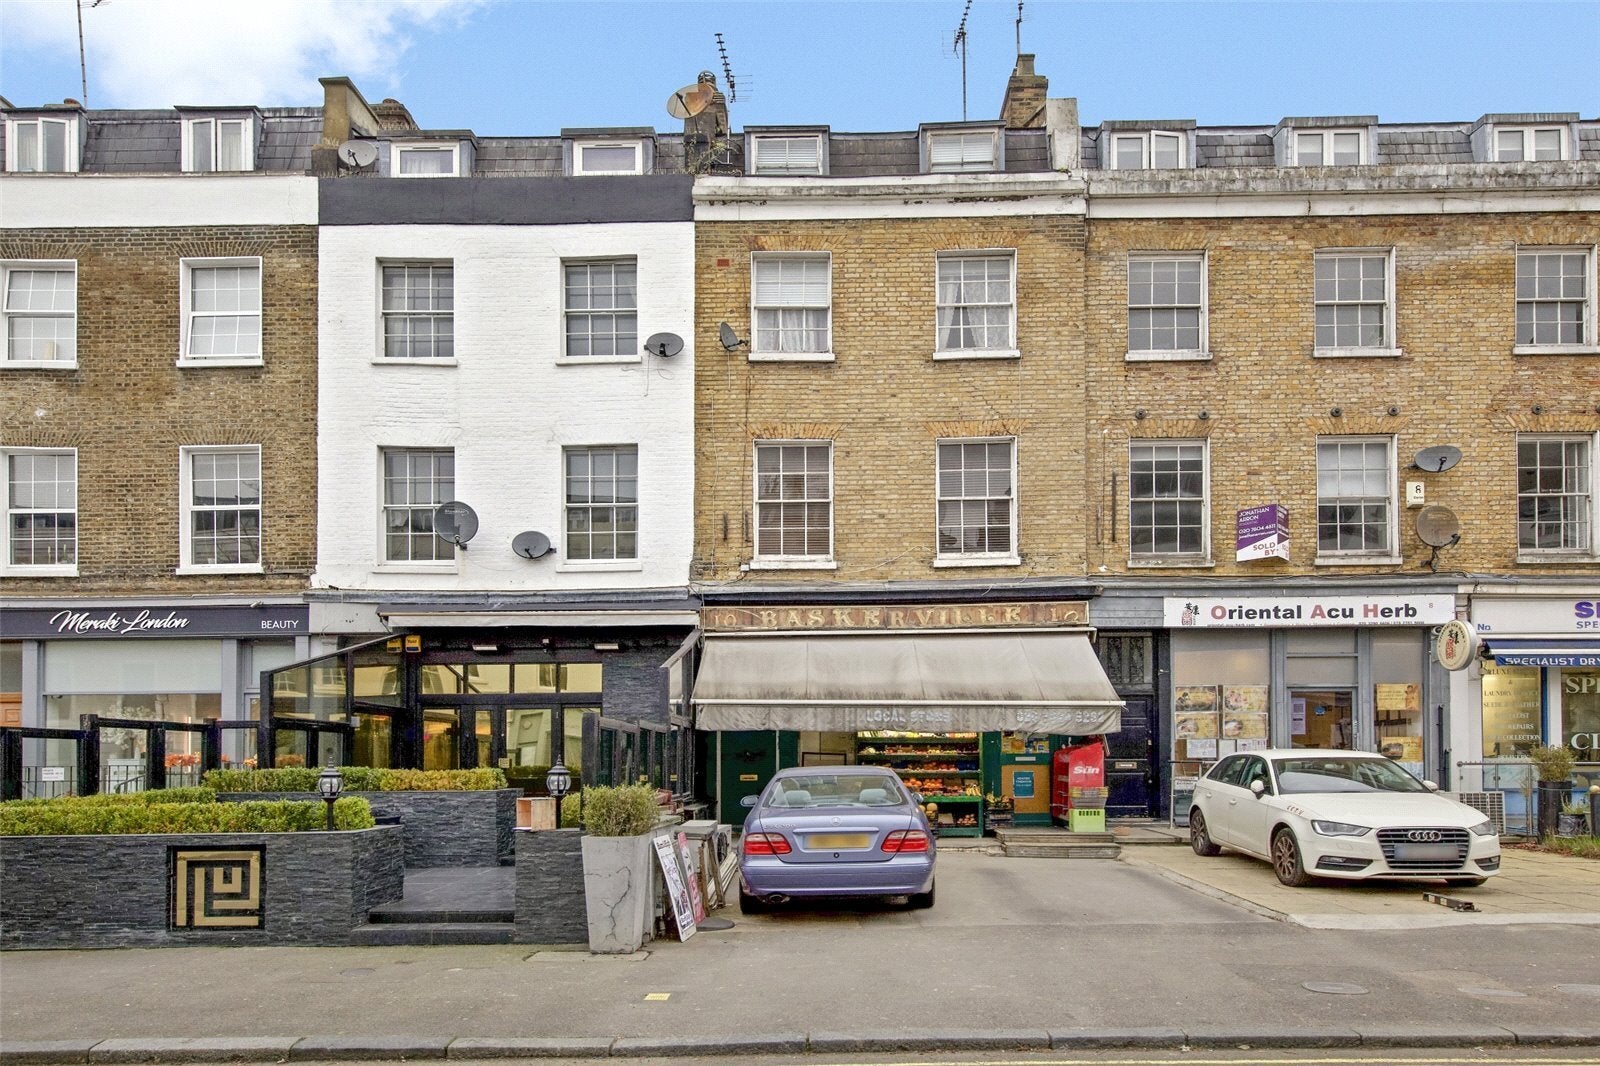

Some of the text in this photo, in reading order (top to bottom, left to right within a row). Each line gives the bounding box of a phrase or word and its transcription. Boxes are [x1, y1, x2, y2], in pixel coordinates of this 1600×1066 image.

[1239, 506, 1270, 518] JONATHAN
[1253, 542, 1276, 551] SOLD
[760, 606, 1022, 628] BASKERVILLE
[1211, 603, 1417, 620] Oriental Acu Herb
[49, 609, 190, 634] Meraki London
[261, 620, 299, 629] BEAUTY
[1505, 657, 1575, 666] SPECIALIST
[865, 709, 906, 723] LOCAL
[1073, 766, 1100, 775] Sun
